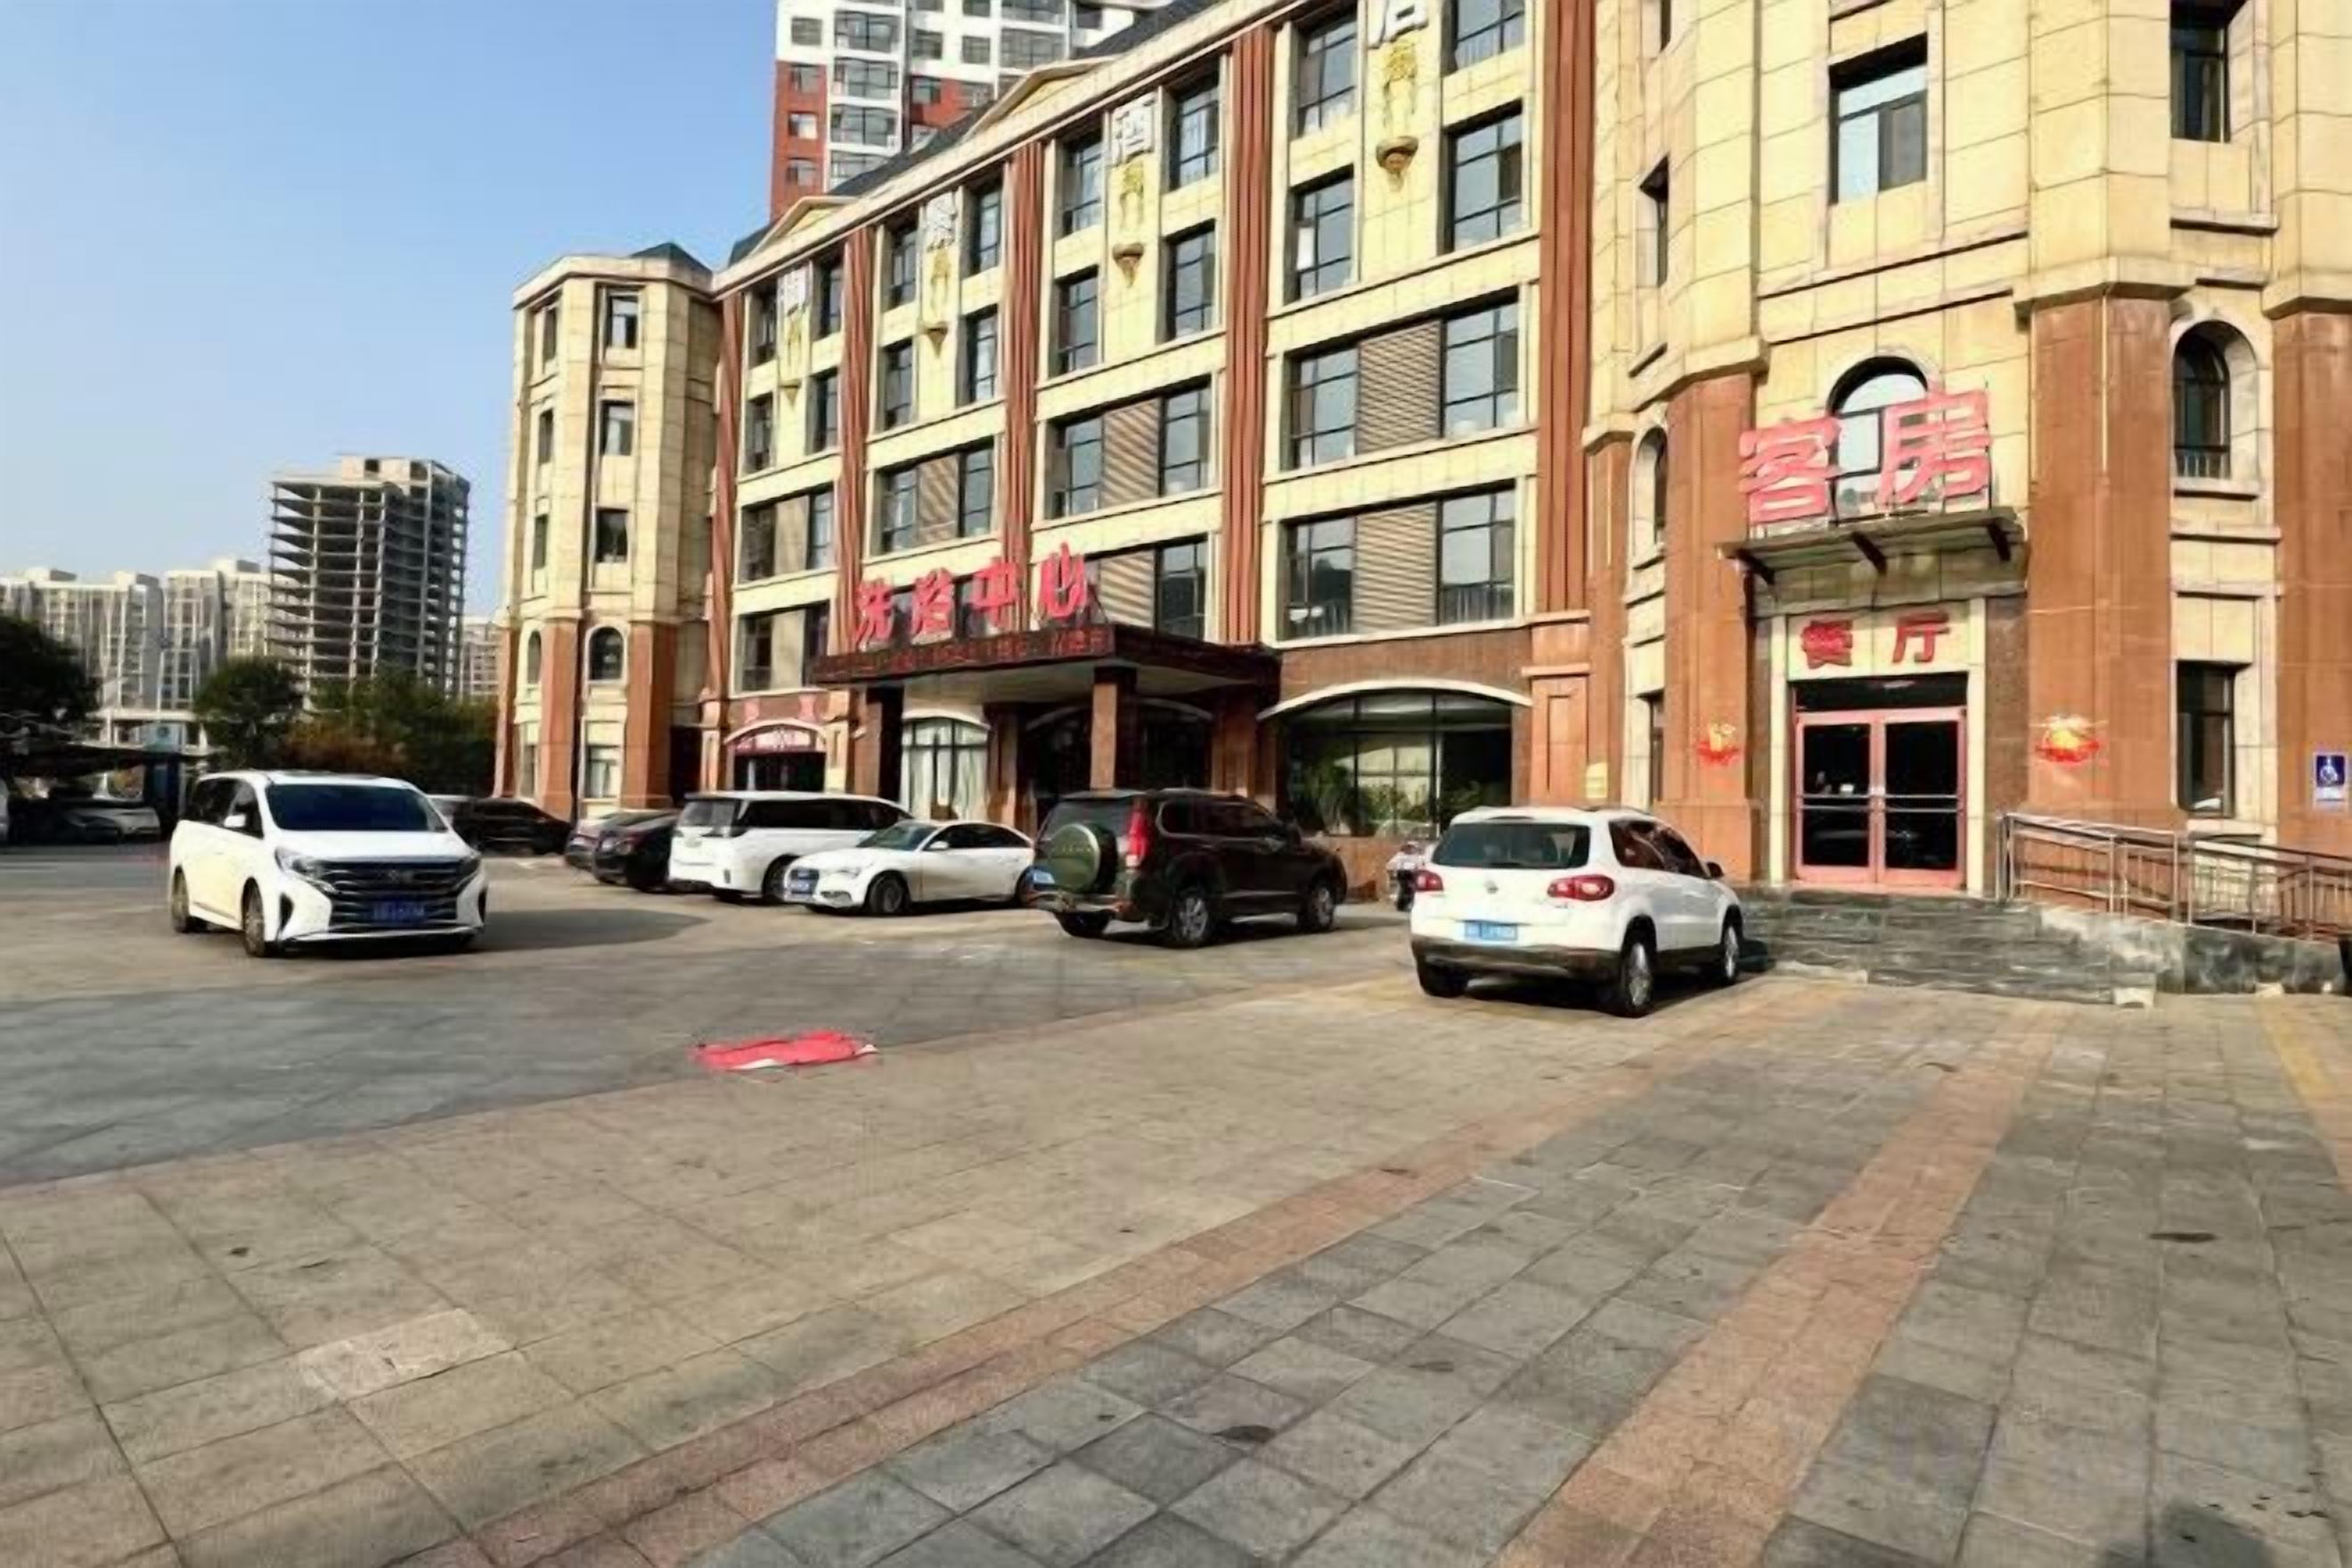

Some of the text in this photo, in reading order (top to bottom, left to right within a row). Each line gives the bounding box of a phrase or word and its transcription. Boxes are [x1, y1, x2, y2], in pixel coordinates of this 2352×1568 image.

[1738, 381, 1992, 524] 客房
[854, 542, 1087, 649] 洗浴中心
[1801, 611, 1950, 668] 餐厅
